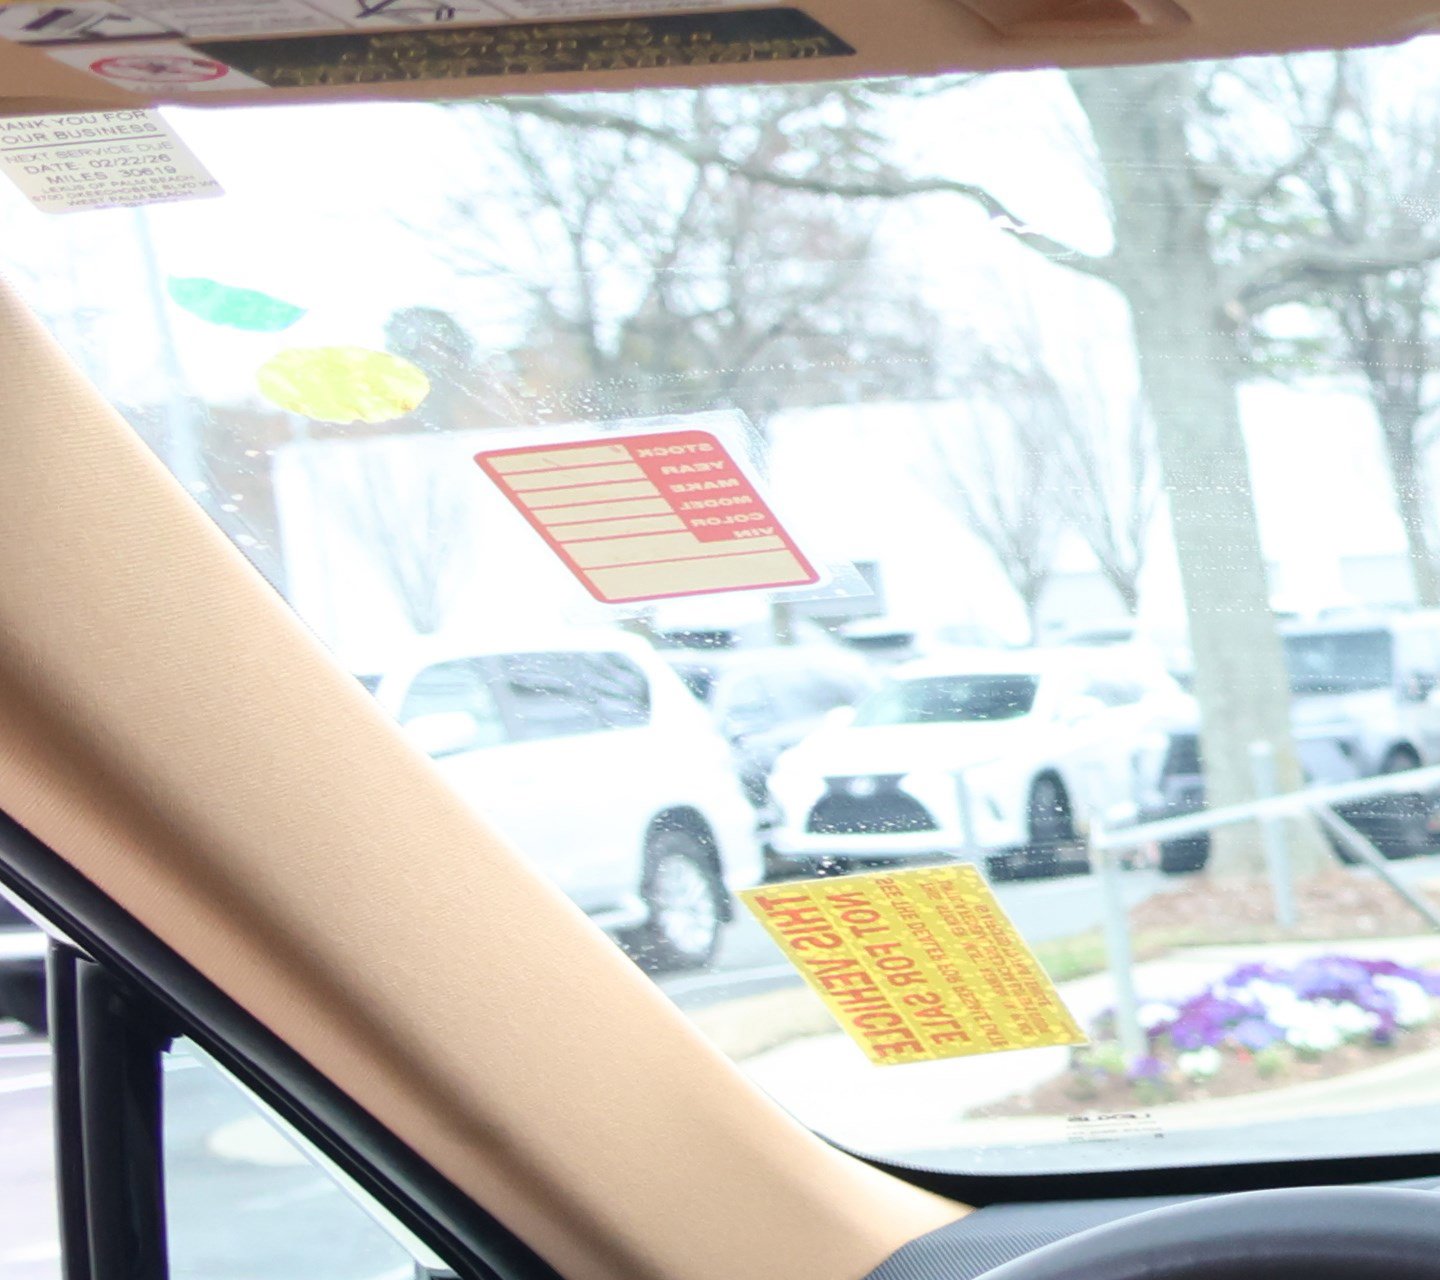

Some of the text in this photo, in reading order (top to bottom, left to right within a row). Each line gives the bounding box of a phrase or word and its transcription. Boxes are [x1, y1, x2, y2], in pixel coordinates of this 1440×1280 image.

[0, 110, 149, 132] ANK YOU FOR
[53, 123, 157, 141] BUSINESS
[24, 161, 79, 175] DATE
[46, 172, 109, 185] MILES
